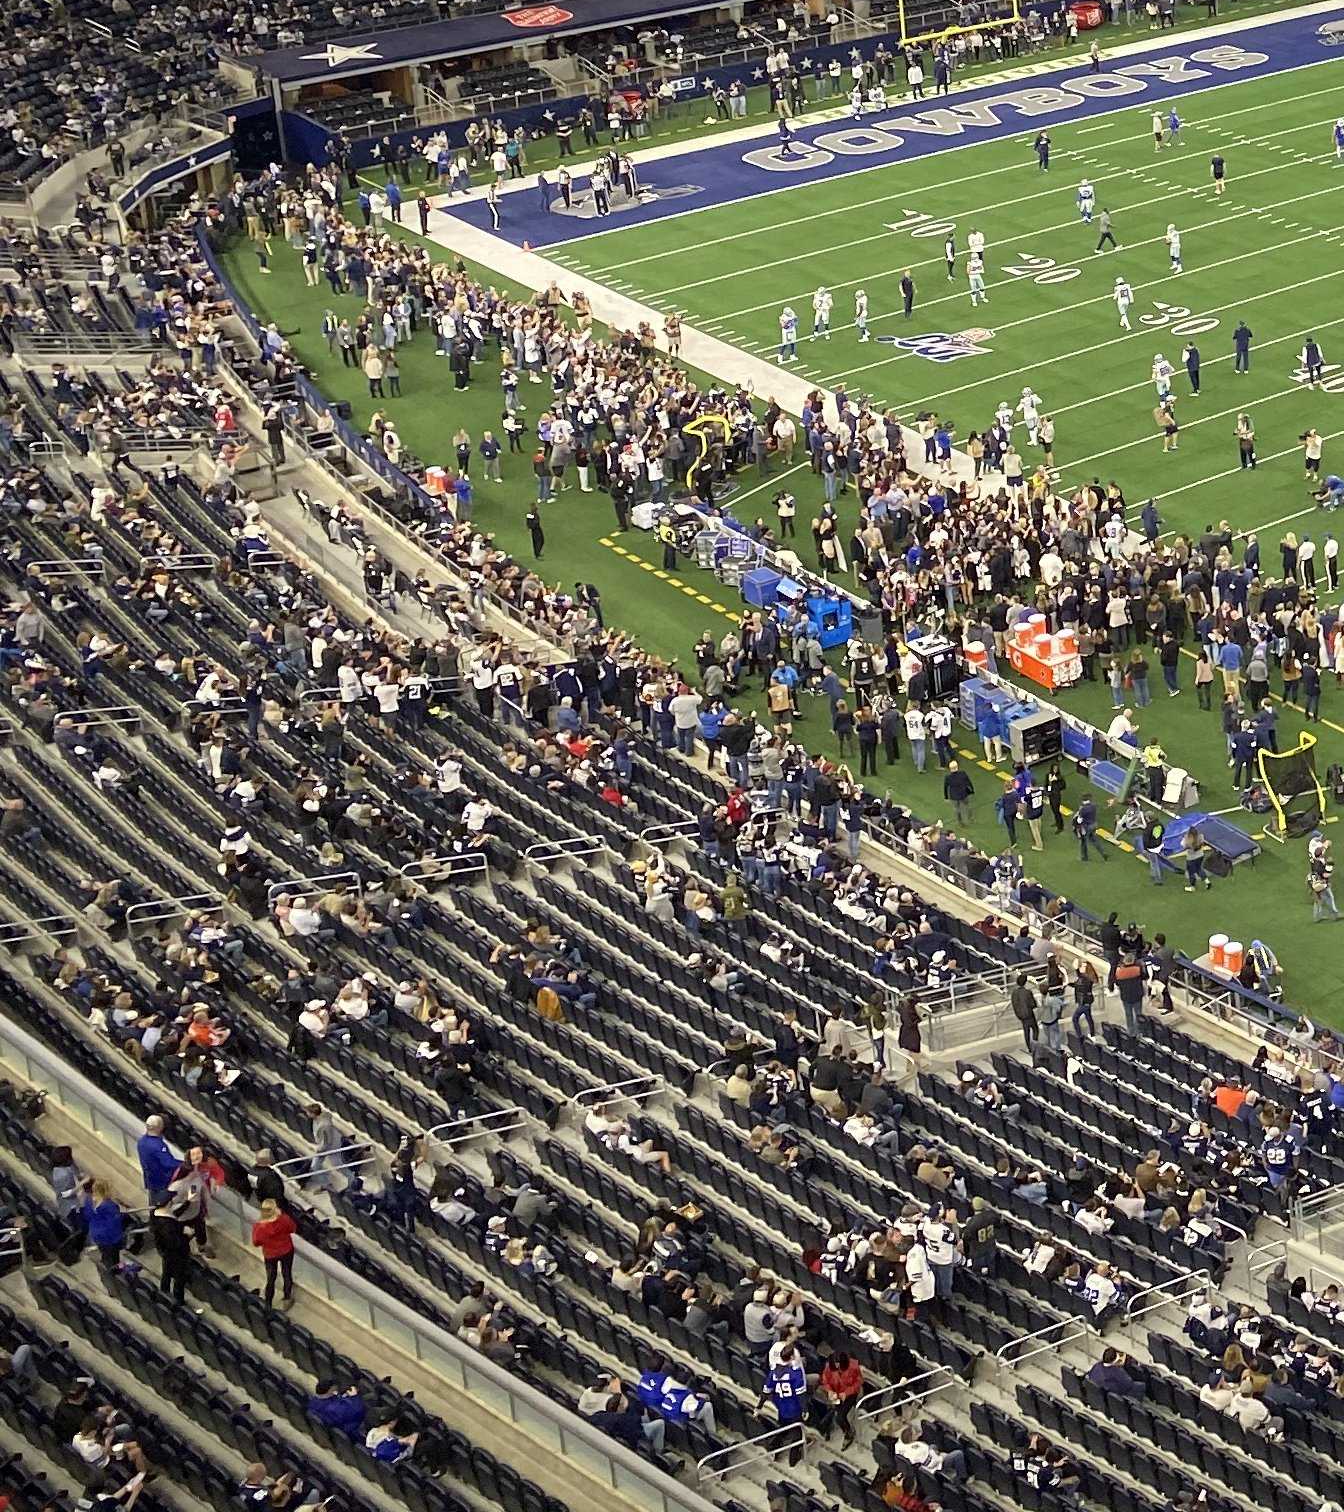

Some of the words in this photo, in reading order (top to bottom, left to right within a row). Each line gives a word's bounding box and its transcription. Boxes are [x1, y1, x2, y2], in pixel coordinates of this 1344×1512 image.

[742, 45, 1270, 172] COWBOYS
[882, 213, 957, 238] 10
[1001, 256, 1082, 285] 20
[1139, 305, 1221, 337] 30
[775, 1382, 792, 1399] 49
